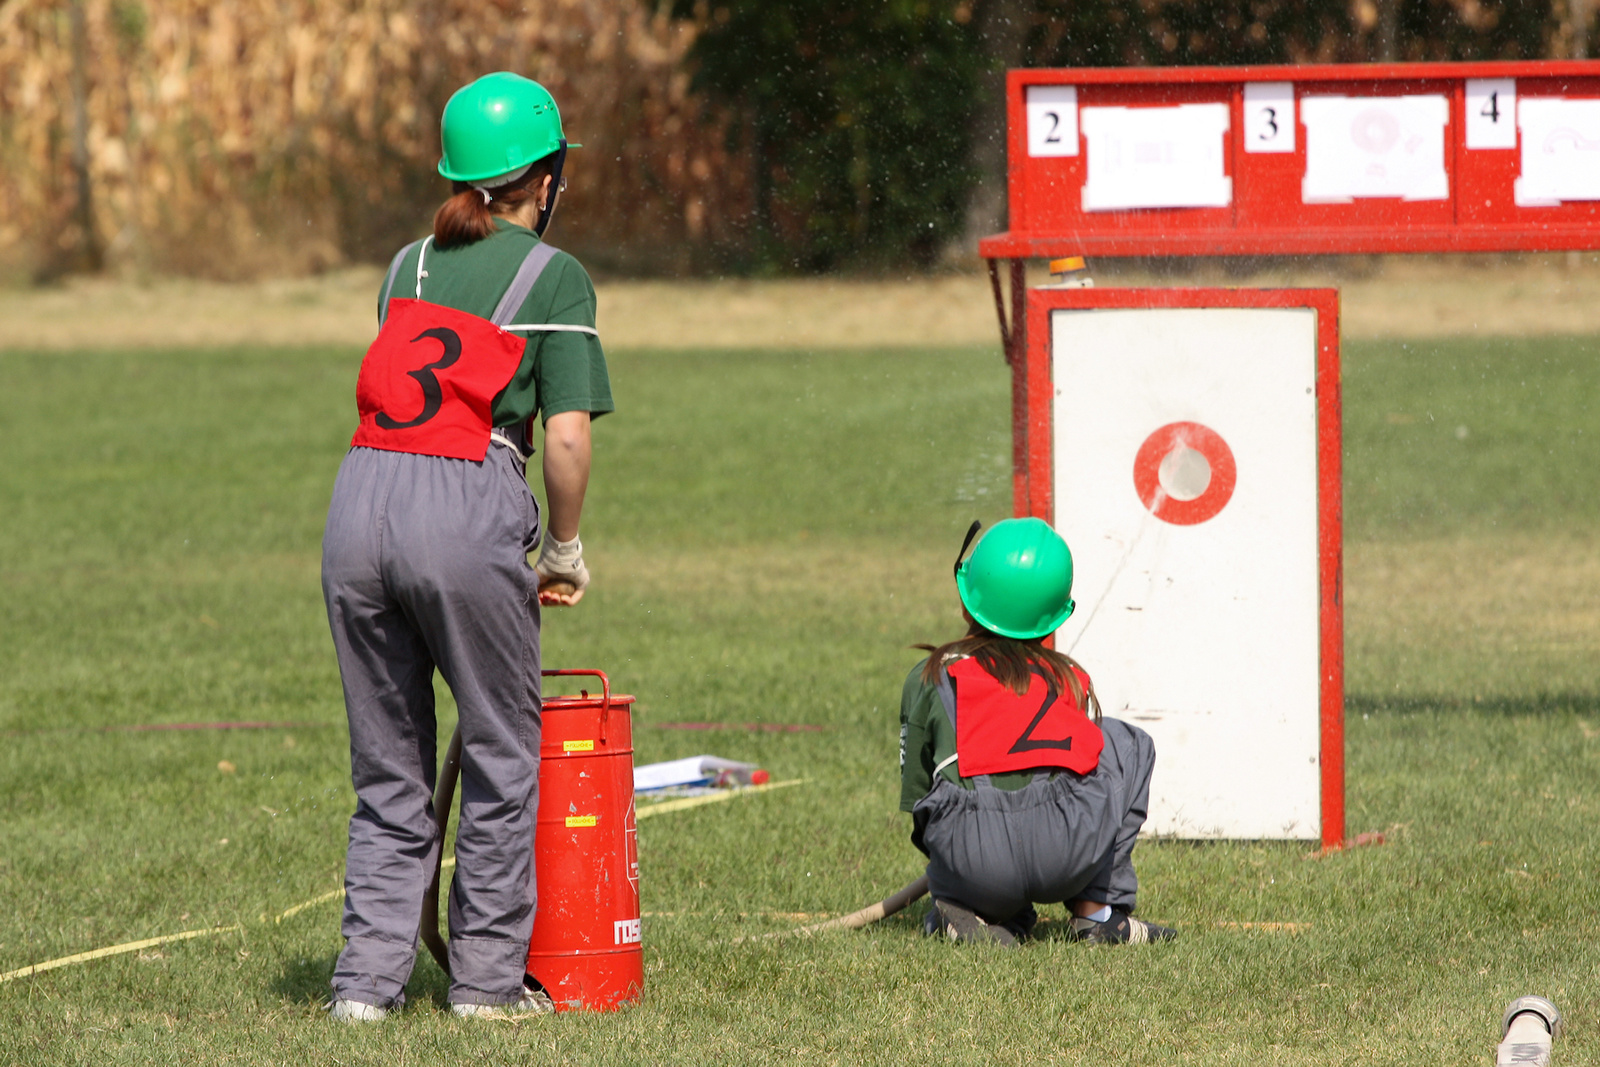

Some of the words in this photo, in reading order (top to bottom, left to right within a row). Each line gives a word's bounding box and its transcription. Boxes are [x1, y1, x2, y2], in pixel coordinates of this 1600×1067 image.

[1480, 90, 1500, 123] 4
[1043, 111, 1061, 143] 2
[1259, 107, 1278, 141] 3
[375, 327, 462, 429] 3
[1007, 664, 1072, 755] 2
